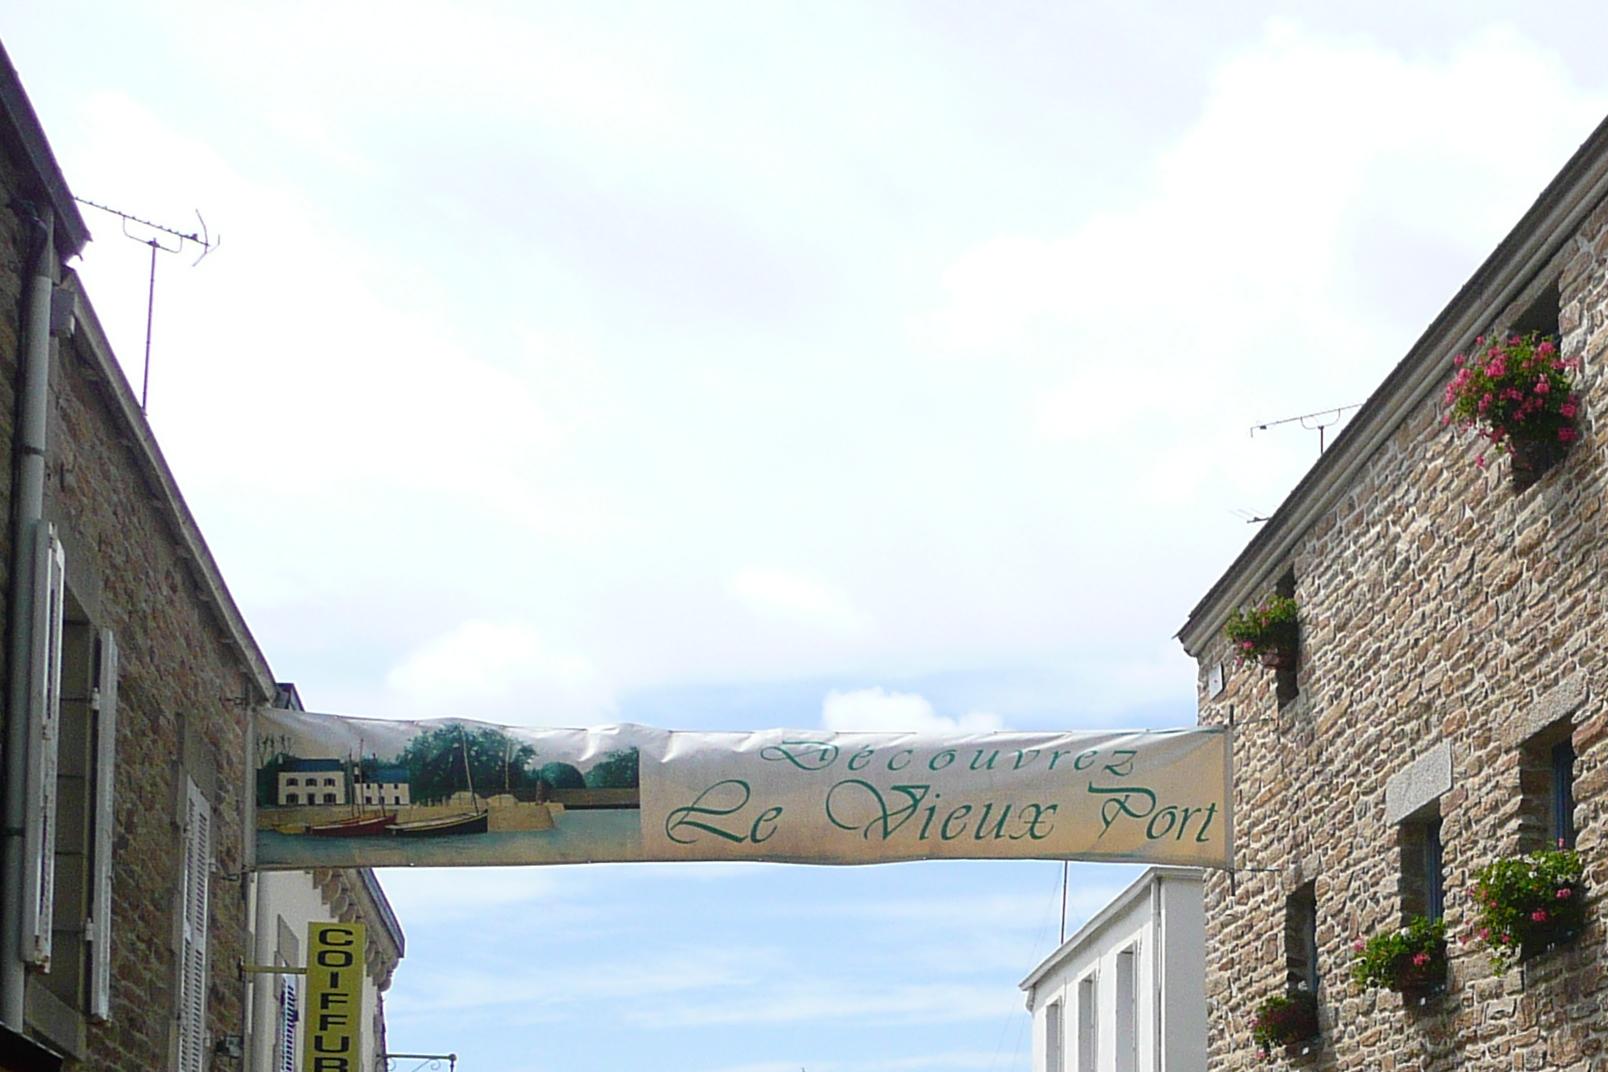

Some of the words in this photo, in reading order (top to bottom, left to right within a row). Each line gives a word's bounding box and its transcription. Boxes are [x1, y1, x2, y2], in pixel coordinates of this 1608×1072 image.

[759, 739, 1138, 777] Découvrez
[665, 778, 784, 846] Le
[824, 777, 1058, 842] Vieux
[1087, 779, 1219, 843] Port
